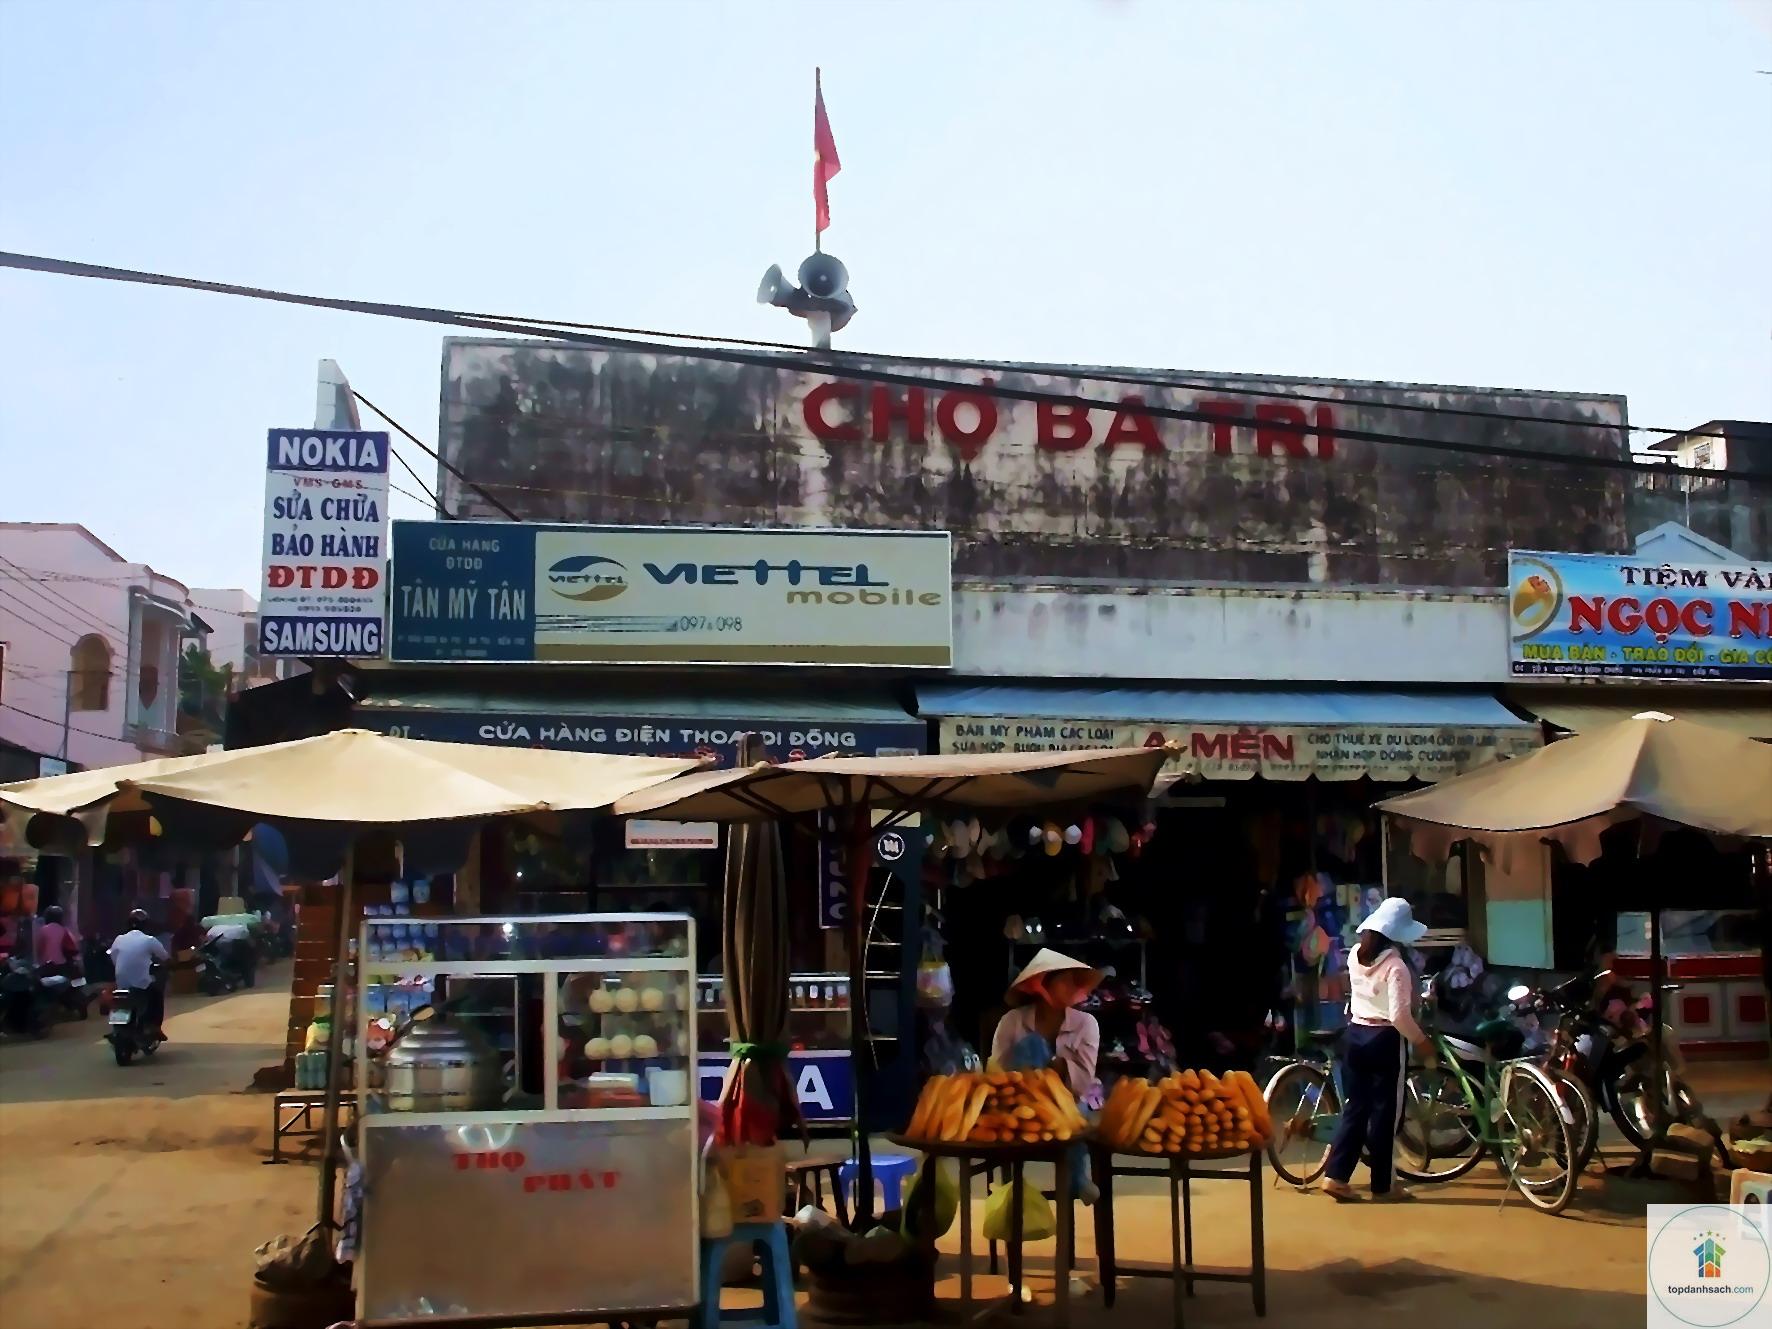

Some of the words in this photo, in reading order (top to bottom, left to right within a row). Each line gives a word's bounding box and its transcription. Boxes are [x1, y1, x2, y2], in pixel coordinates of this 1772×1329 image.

[1036, 394, 1165, 455] BA
[1199, 400, 1336, 460] TRI
[278, 436, 379, 467] NOKIA
[273, 489, 313, 520] SỬA
[321, 493, 379, 522] CHỮA
[272, 524, 314, 556] BẢO
[321, 527, 379, 557] HÀNH
[267, 565, 379, 590] ĐTDĐ
[1620, 564, 1708, 589] TIỆM
[401, 578, 439, 619] TÂN
[448, 580, 478, 619] MỸ
[488, 580, 526, 620] TÂN
[787, 588, 942, 606] mobile
[680, 616, 706, 632] 097
[716, 616, 743, 632] 098
[1568, 596, 1714, 644] NGỌC
[264, 621, 379, 653] SAMSUNG
[1522, 644, 1563, 661] MUA
[1622, 646, 1669, 663] TRAO
[1719, 649, 1749, 665] GIA
[478, 720, 531, 740] CỬA
[539, 722, 607, 743] HÀNG
[615, 724, 671, 746] ĐIỆN
[789, 728, 856, 750] ĐỘNG
